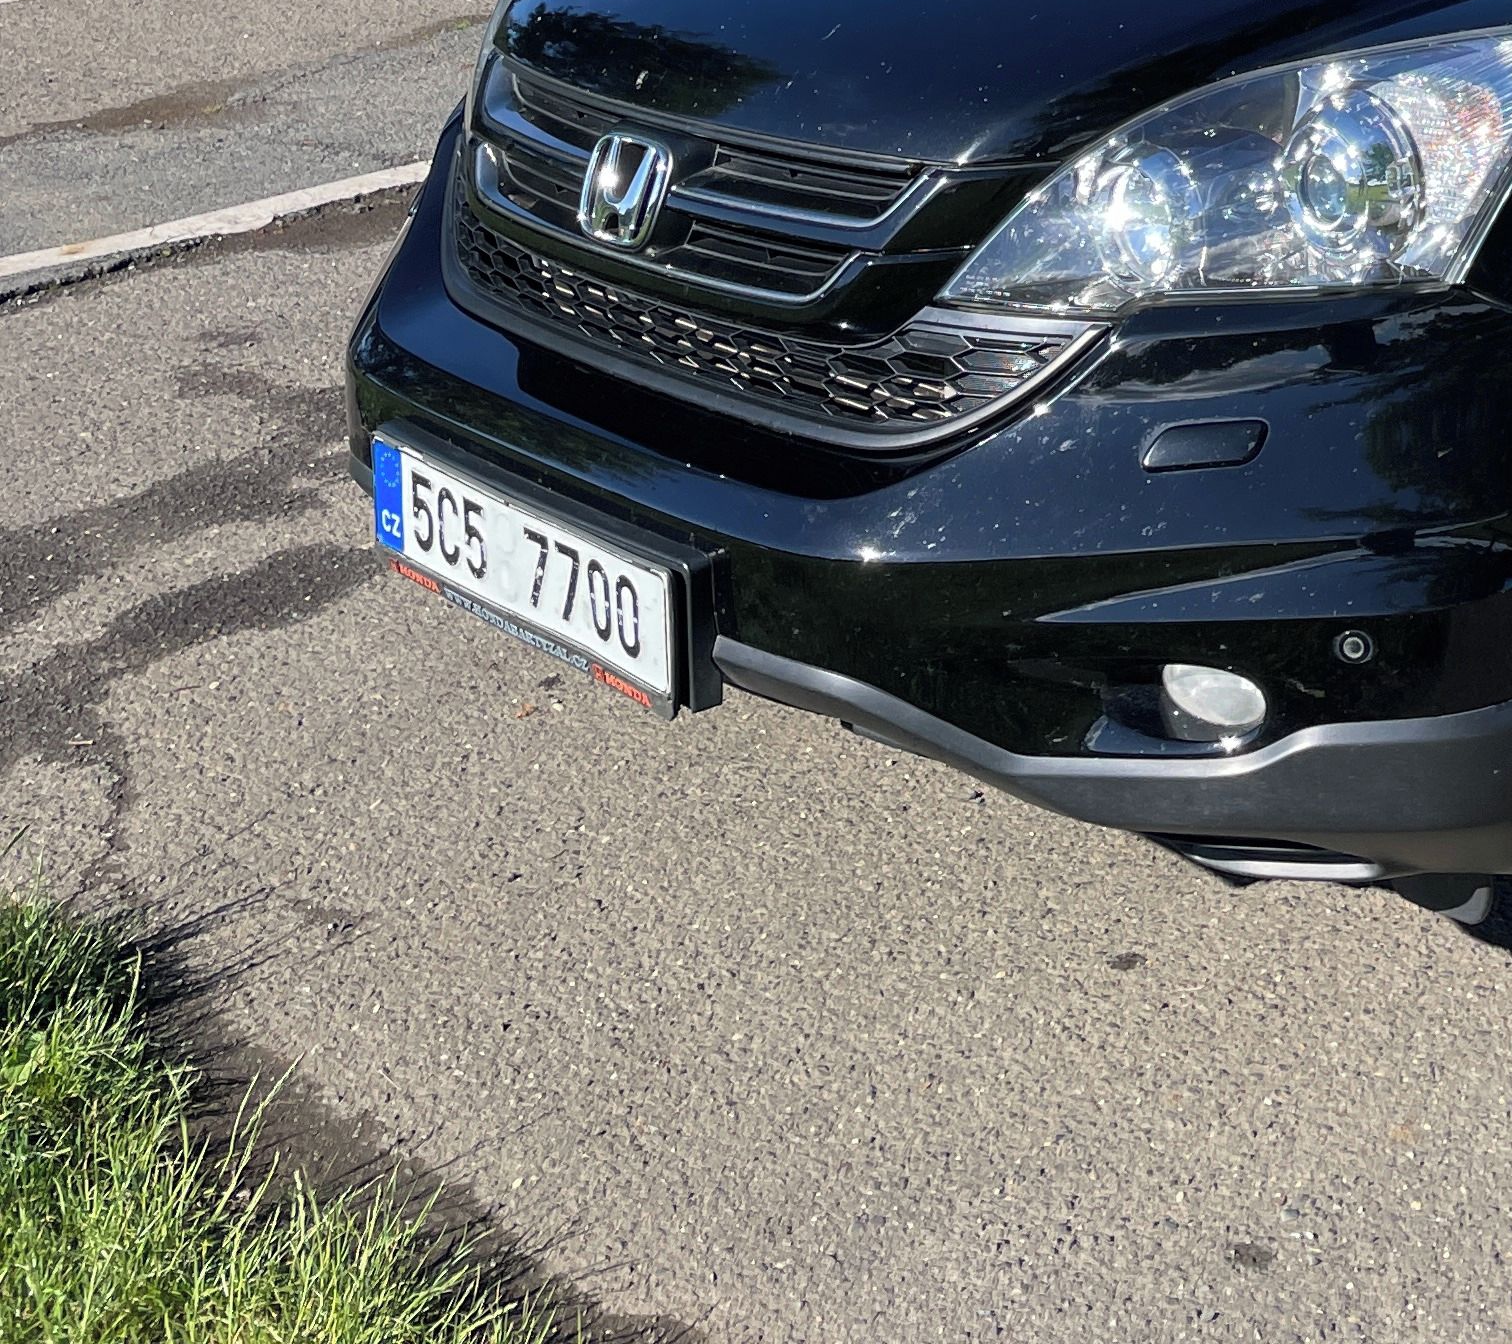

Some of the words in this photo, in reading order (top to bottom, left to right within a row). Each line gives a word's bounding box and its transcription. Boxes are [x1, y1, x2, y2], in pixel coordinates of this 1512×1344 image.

[381, 509, 401, 538] CZ
[411, 469, 487, 579] 5C5
[523, 526, 641, 659] 7700
[399, 564, 442, 594] HONDA
[604, 671, 653, 708] HONDA
